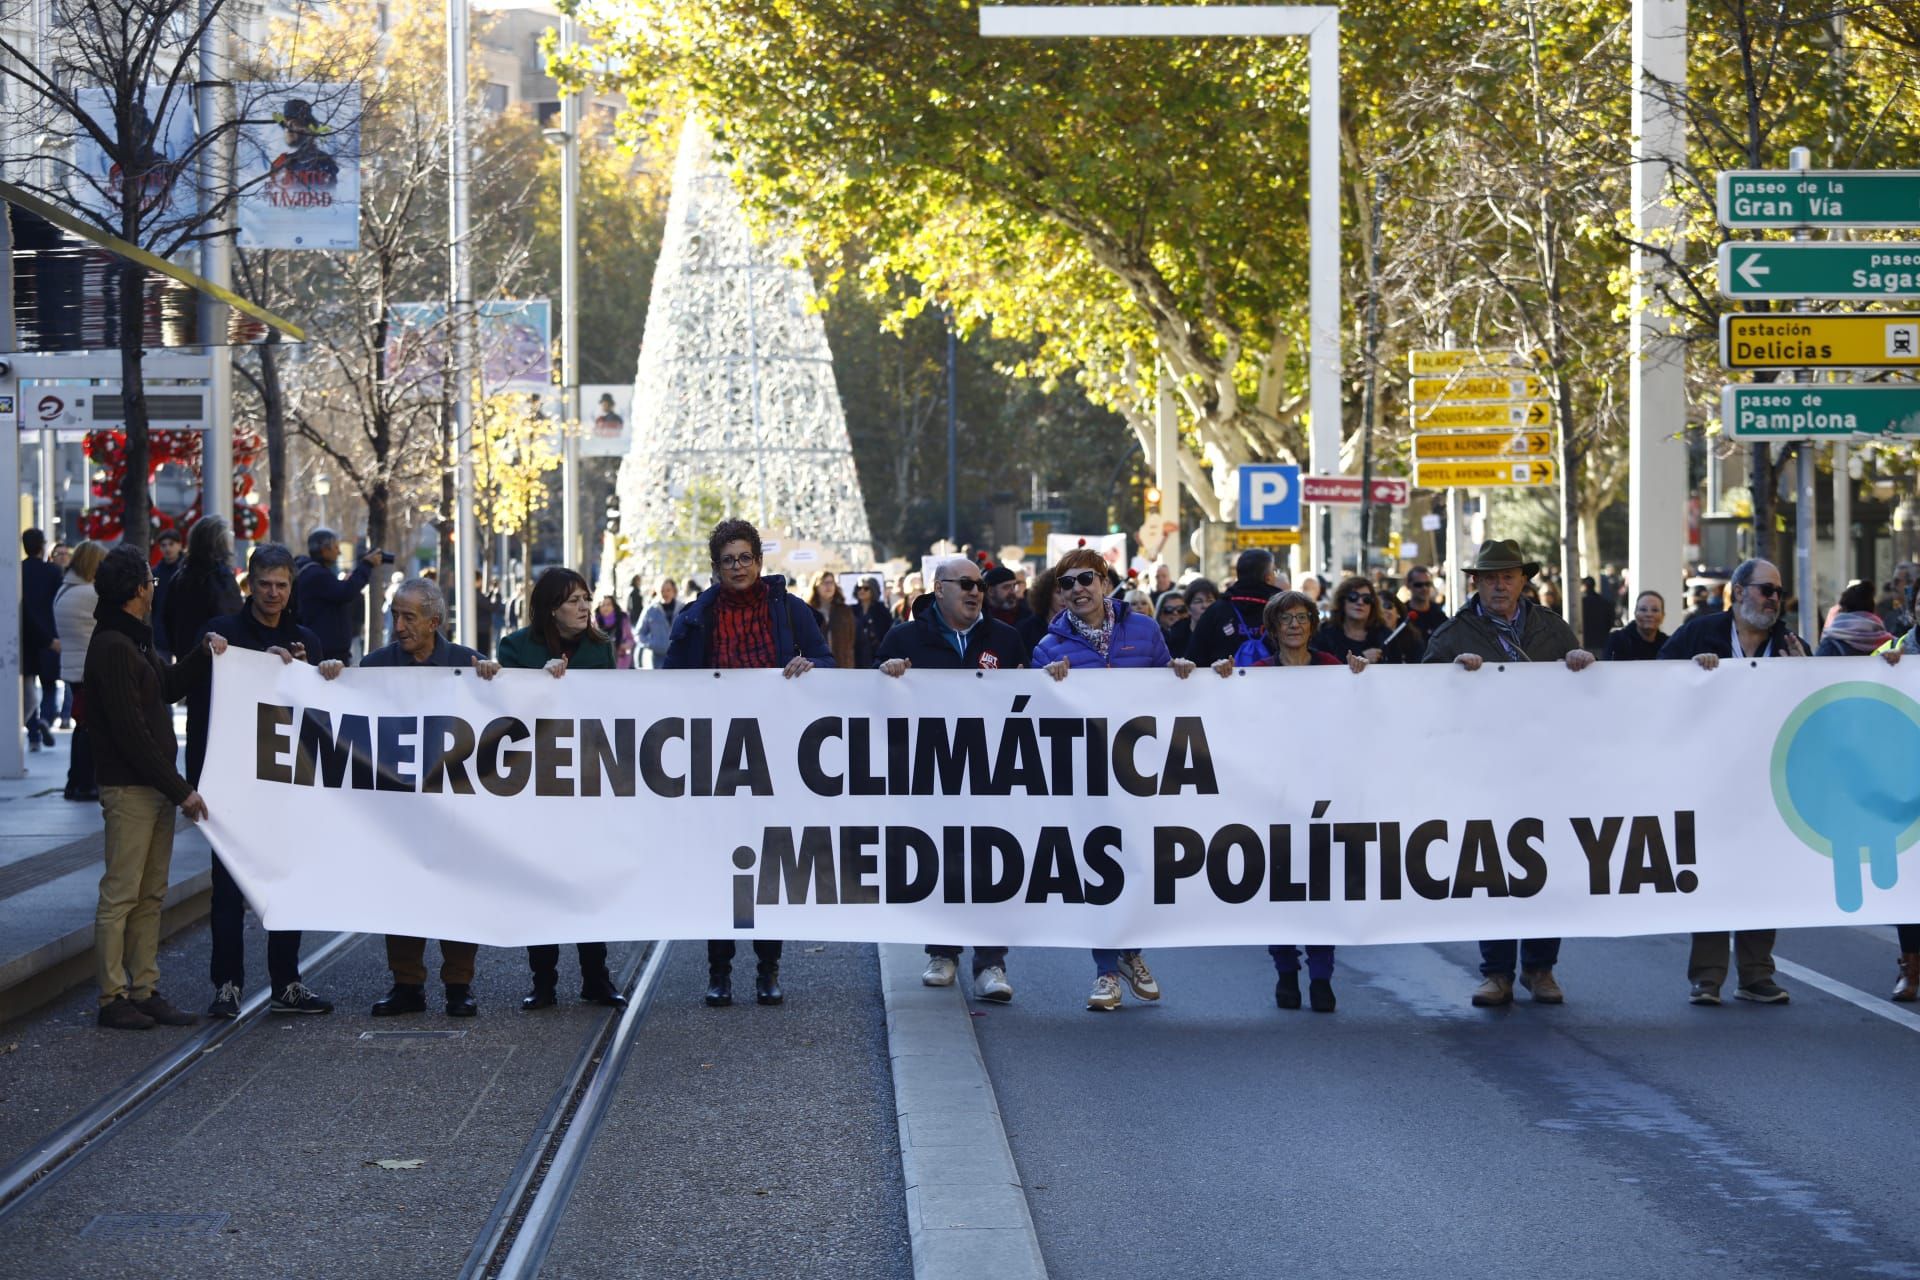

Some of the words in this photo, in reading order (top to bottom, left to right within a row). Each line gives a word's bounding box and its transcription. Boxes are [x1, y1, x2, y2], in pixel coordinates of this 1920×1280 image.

[1735, 183, 1786, 196] paseo
[1797, 181, 1817, 194] de
[1828, 181, 1844, 194] la
[1735, 198, 1793, 216] Gran
[1809, 197, 1842, 216] Vía
[1871, 254, 1920, 268] paseo
[1738, 323, 1812, 336] estación
[1737, 341, 1832, 359] Delicias
[1741, 396, 1792, 409] paseo
[1802, 394, 1822, 406] de
[1741, 411, 1857, 432] Pamplona
[1418, 441, 1449, 451] HOTEL
[1455, 440, 1500, 450] ALFONSO
[1419, 470, 1450, 479] HOTEL
[1456, 469, 1497, 478] AVENIDA
[1251, 472, 1289, 521] P
[1305, 484, 1363, 497] CaixaForu
[257, 703, 774, 797] EMERGENCIA
[798, 695, 1219, 797] CLIMÁTICA
[733, 824, 1124, 928] ¡MEDIDAS
[1154, 800, 1547, 905] POLÍTICAS
[1570, 811, 1698, 895] YA!
